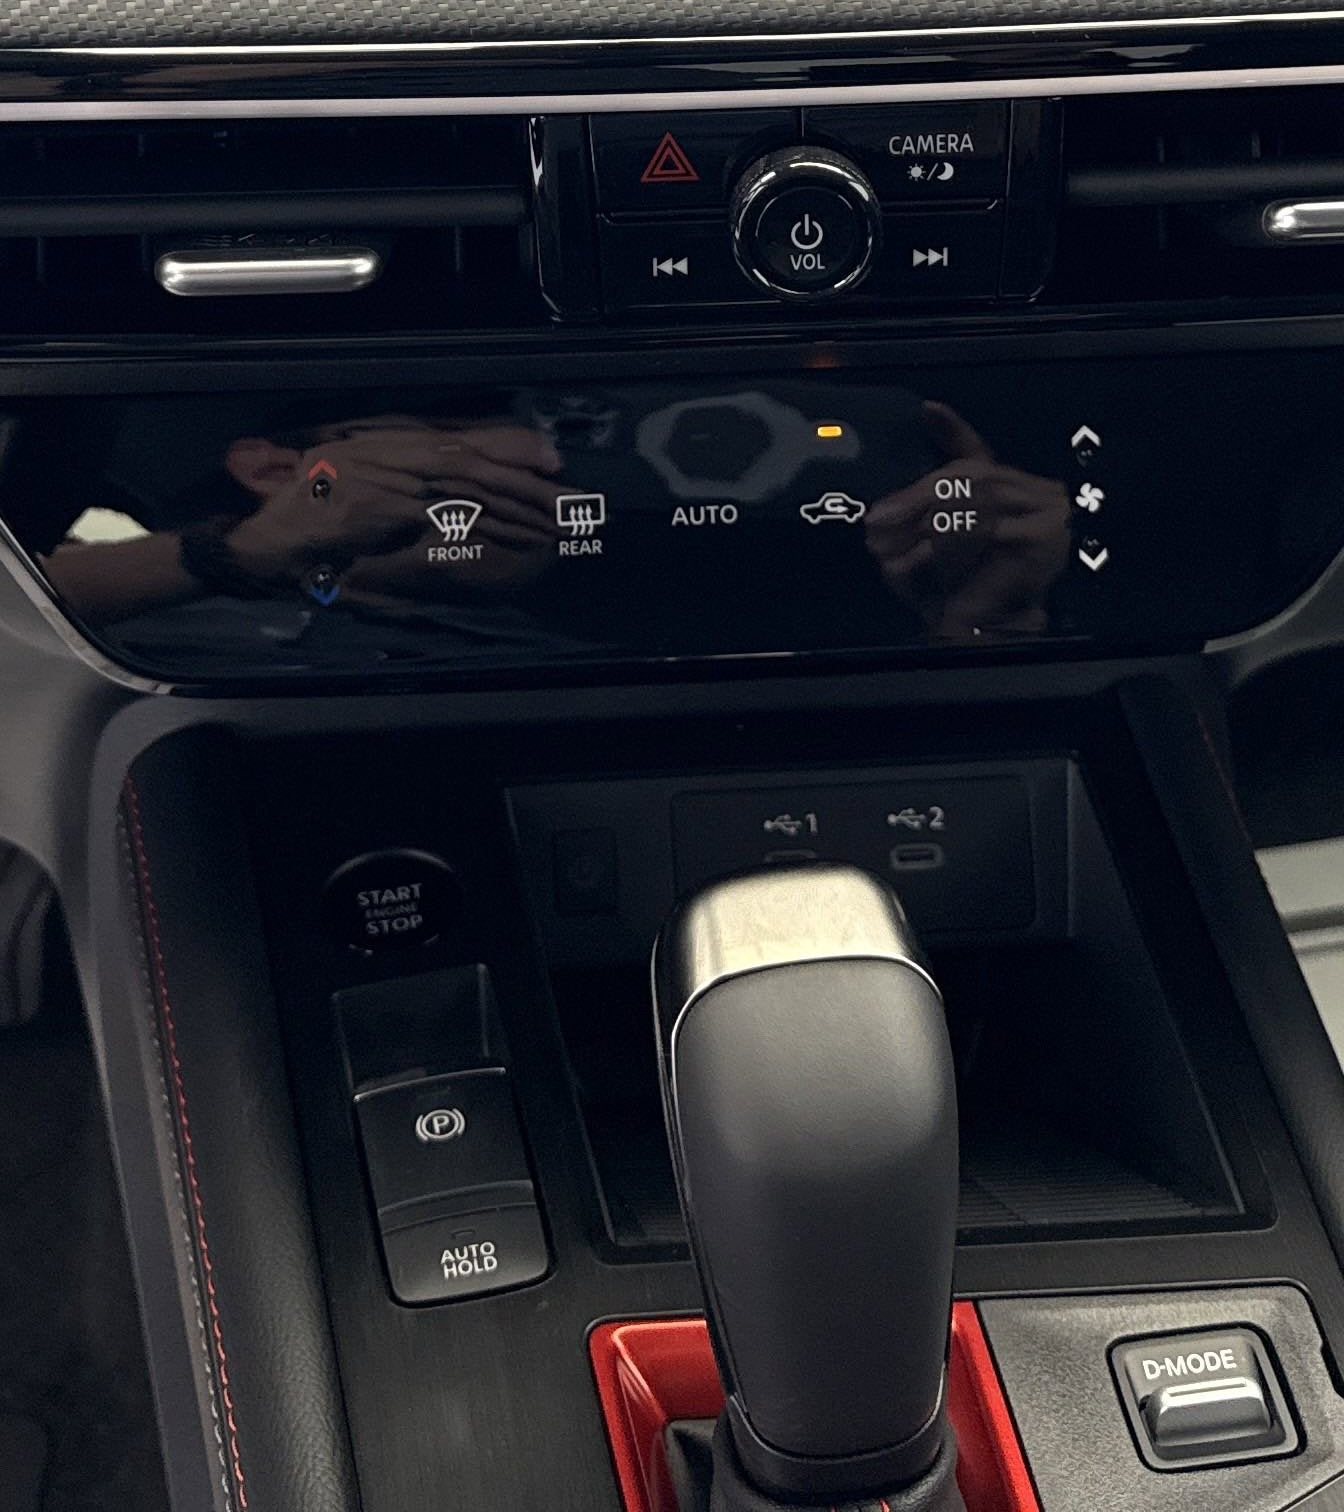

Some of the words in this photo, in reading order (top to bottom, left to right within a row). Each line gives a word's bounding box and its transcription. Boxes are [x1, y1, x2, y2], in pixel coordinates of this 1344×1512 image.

[889, 133, 974, 154] CAMERA
[790, 253, 826, 271] VOL
[934, 479, 971, 499] ON
[671, 504, 739, 526] AUTO
[932, 511, 977, 533] OFF
[427, 544, 484, 562] FRONT
[559, 540, 603, 556] REAR
[805, 813, 819, 834] 1
[929, 806, 945, 829] 2
[357, 883, 423, 906] START
[366, 913, 423, 936] STOP
[440, 1241, 496, 1265] AUTO
[444, 1255, 498, 1279] HOLD
[1142, 1349, 1237, 1380] D-MODE
